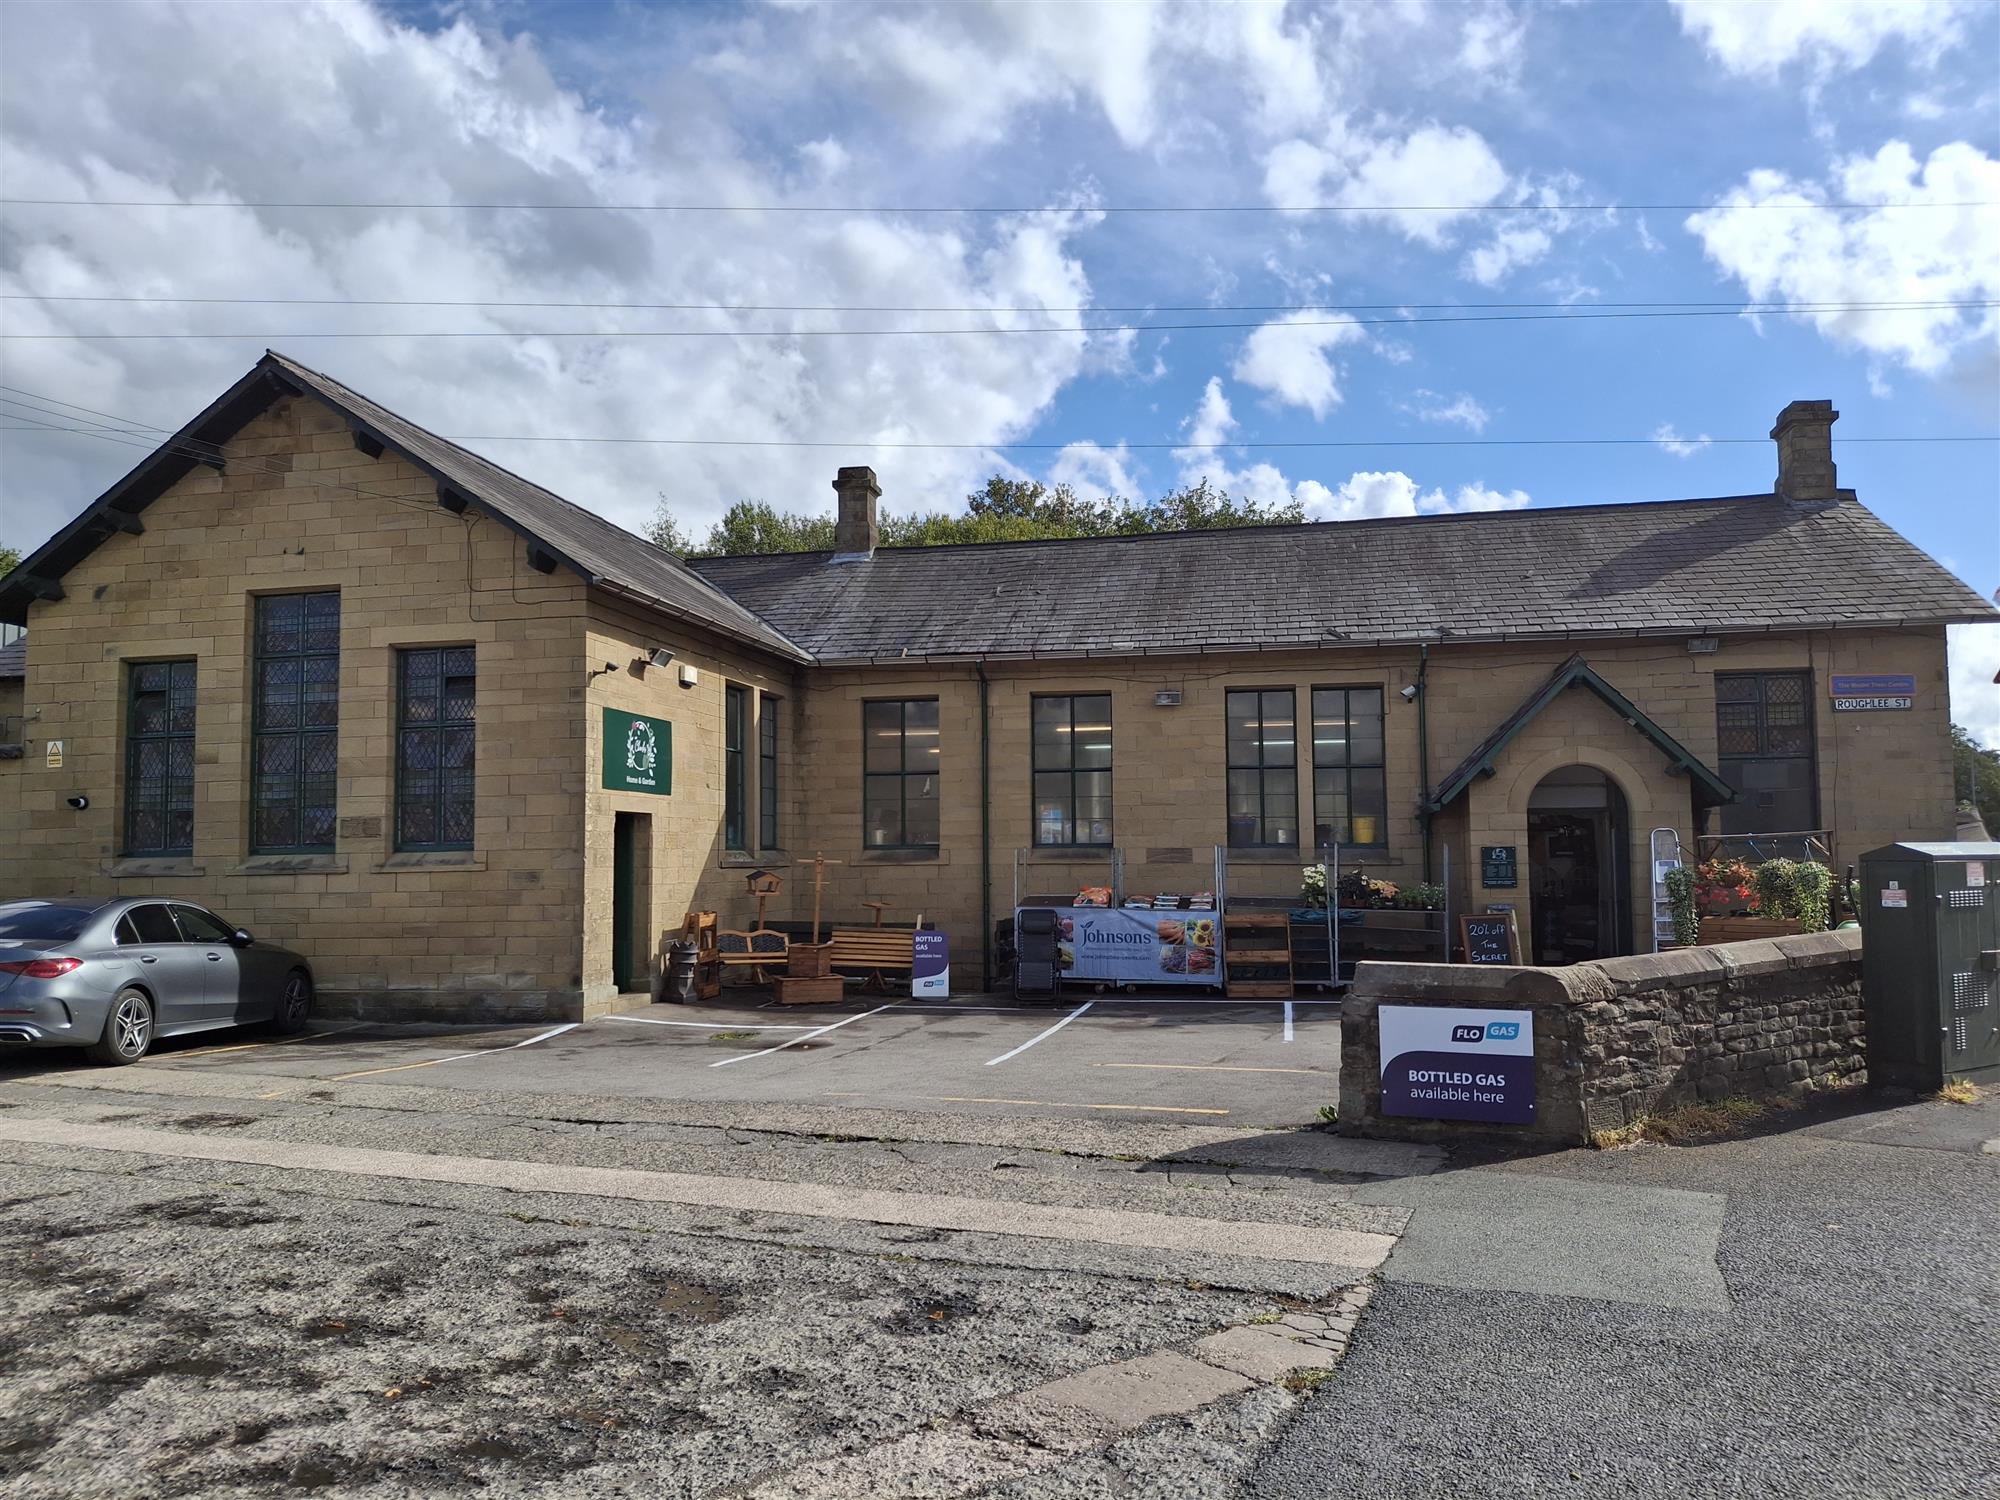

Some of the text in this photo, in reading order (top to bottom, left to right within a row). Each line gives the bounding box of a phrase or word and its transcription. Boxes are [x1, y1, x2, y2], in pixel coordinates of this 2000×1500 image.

[1837, 699, 1889, 709] ROUGHLEE
[1469, 923, 1506, 936] 20% off
[1081, 928, 1152, 947] Johnsons
[1456, 1026, 1515, 1039] FLO GAS
[1408, 1070, 1506, 1087] BOTTLED GAS
[1410, 1087, 1505, 1103] available here
